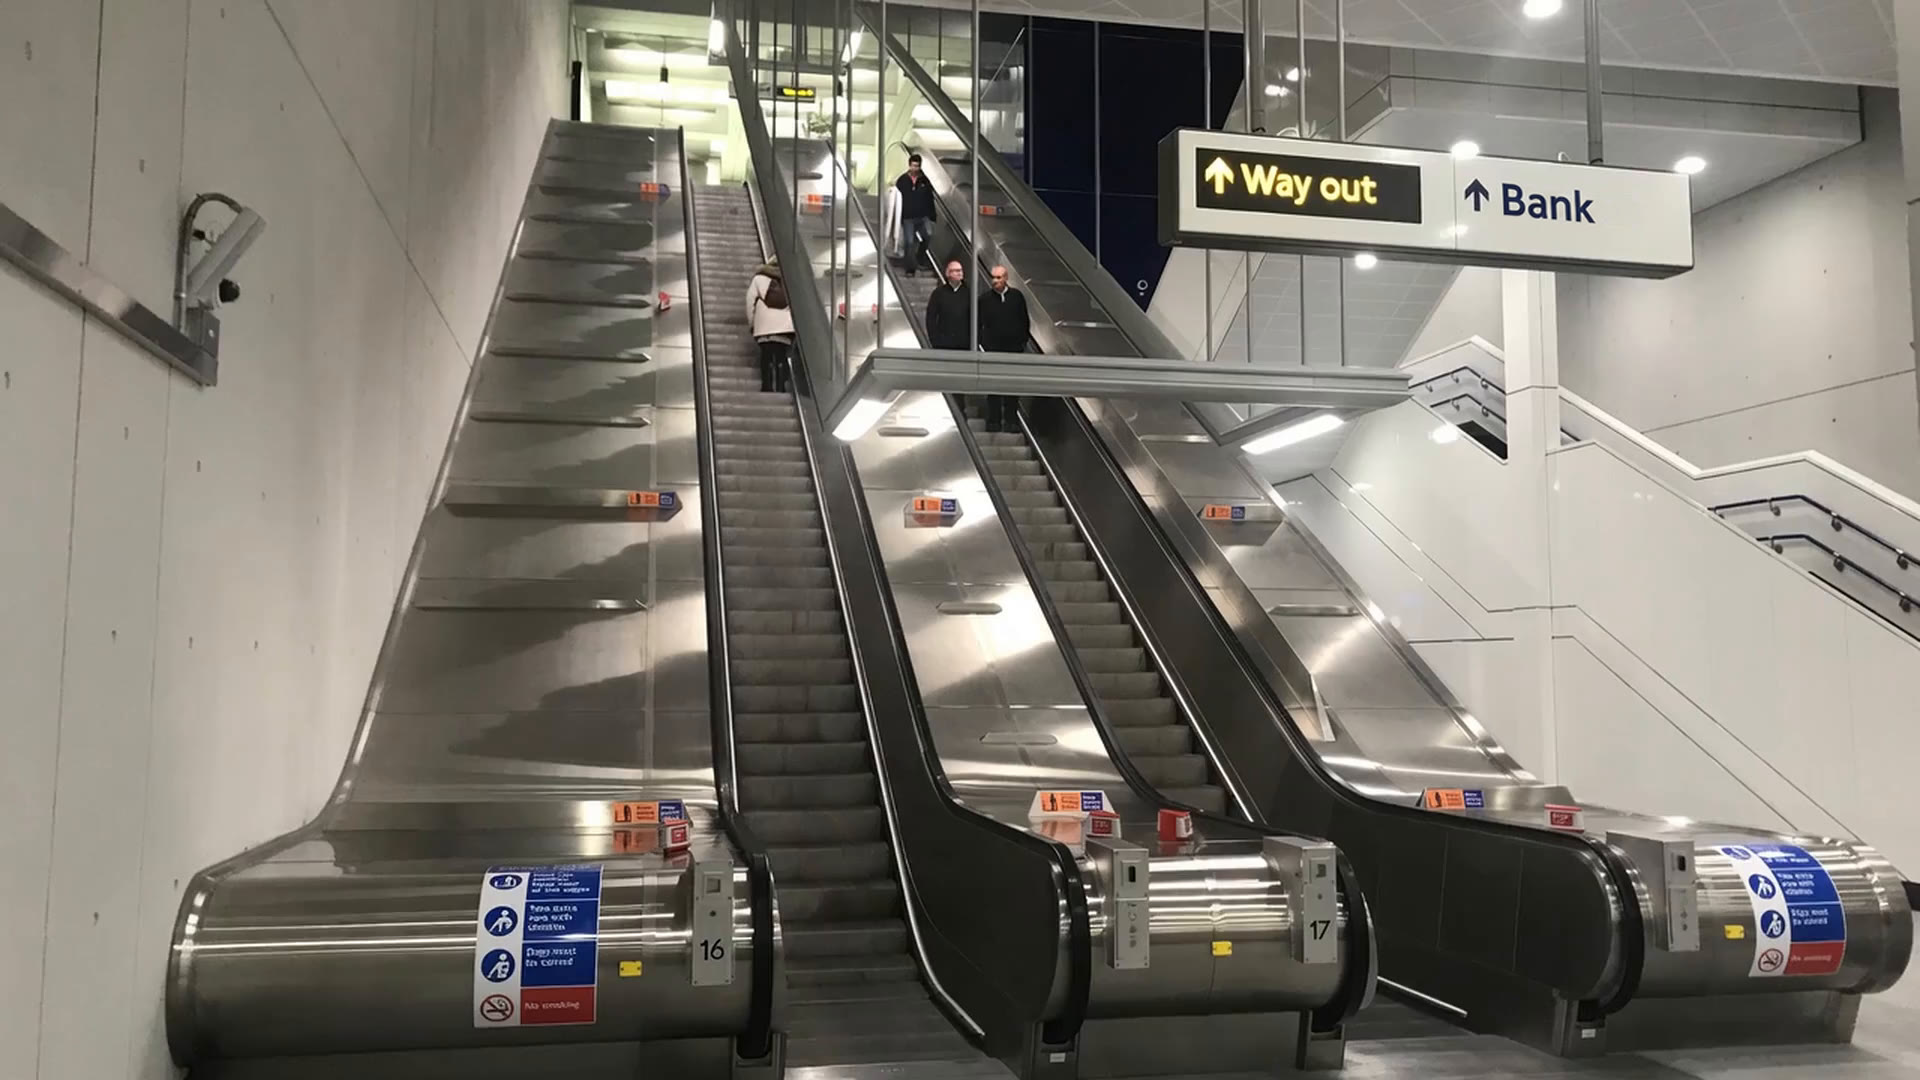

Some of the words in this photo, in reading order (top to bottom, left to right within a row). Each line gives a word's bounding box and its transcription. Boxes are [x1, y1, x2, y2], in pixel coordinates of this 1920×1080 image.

[1240, 163, 1313, 206] Way
[1319, 175, 1378, 205] out
[1502, 183, 1596, 224] Bank
[1310, 920, 1331, 940] 17
[700, 938, 725, 960] 16
